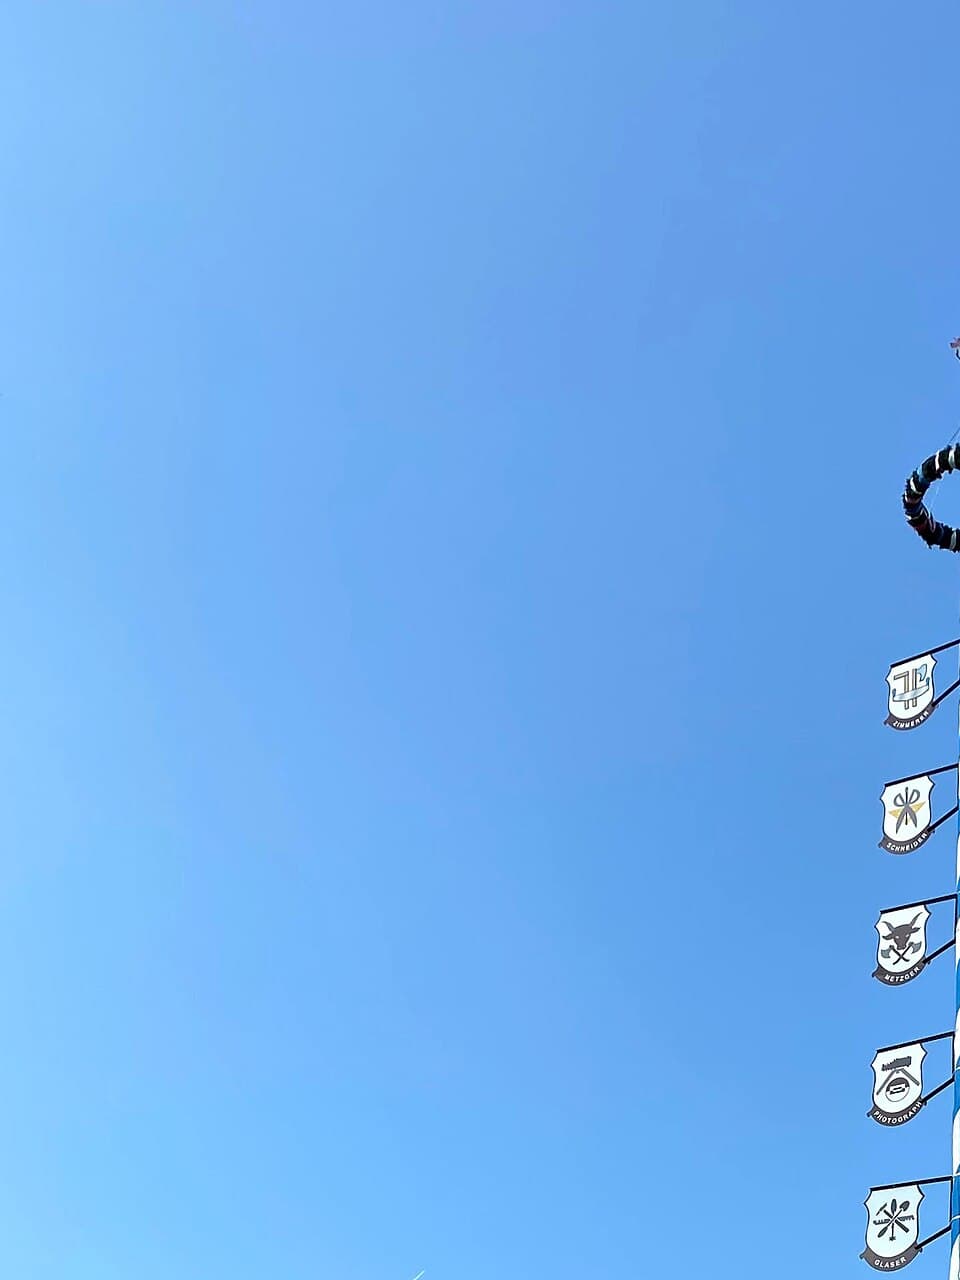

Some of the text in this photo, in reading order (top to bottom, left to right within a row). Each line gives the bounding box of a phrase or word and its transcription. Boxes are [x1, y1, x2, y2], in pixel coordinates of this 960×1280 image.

[886, 832, 928, 852] SCHNEIDER
[884, 966, 921, 982] METZGER
[874, 1255, 907, 1269] GLASER
